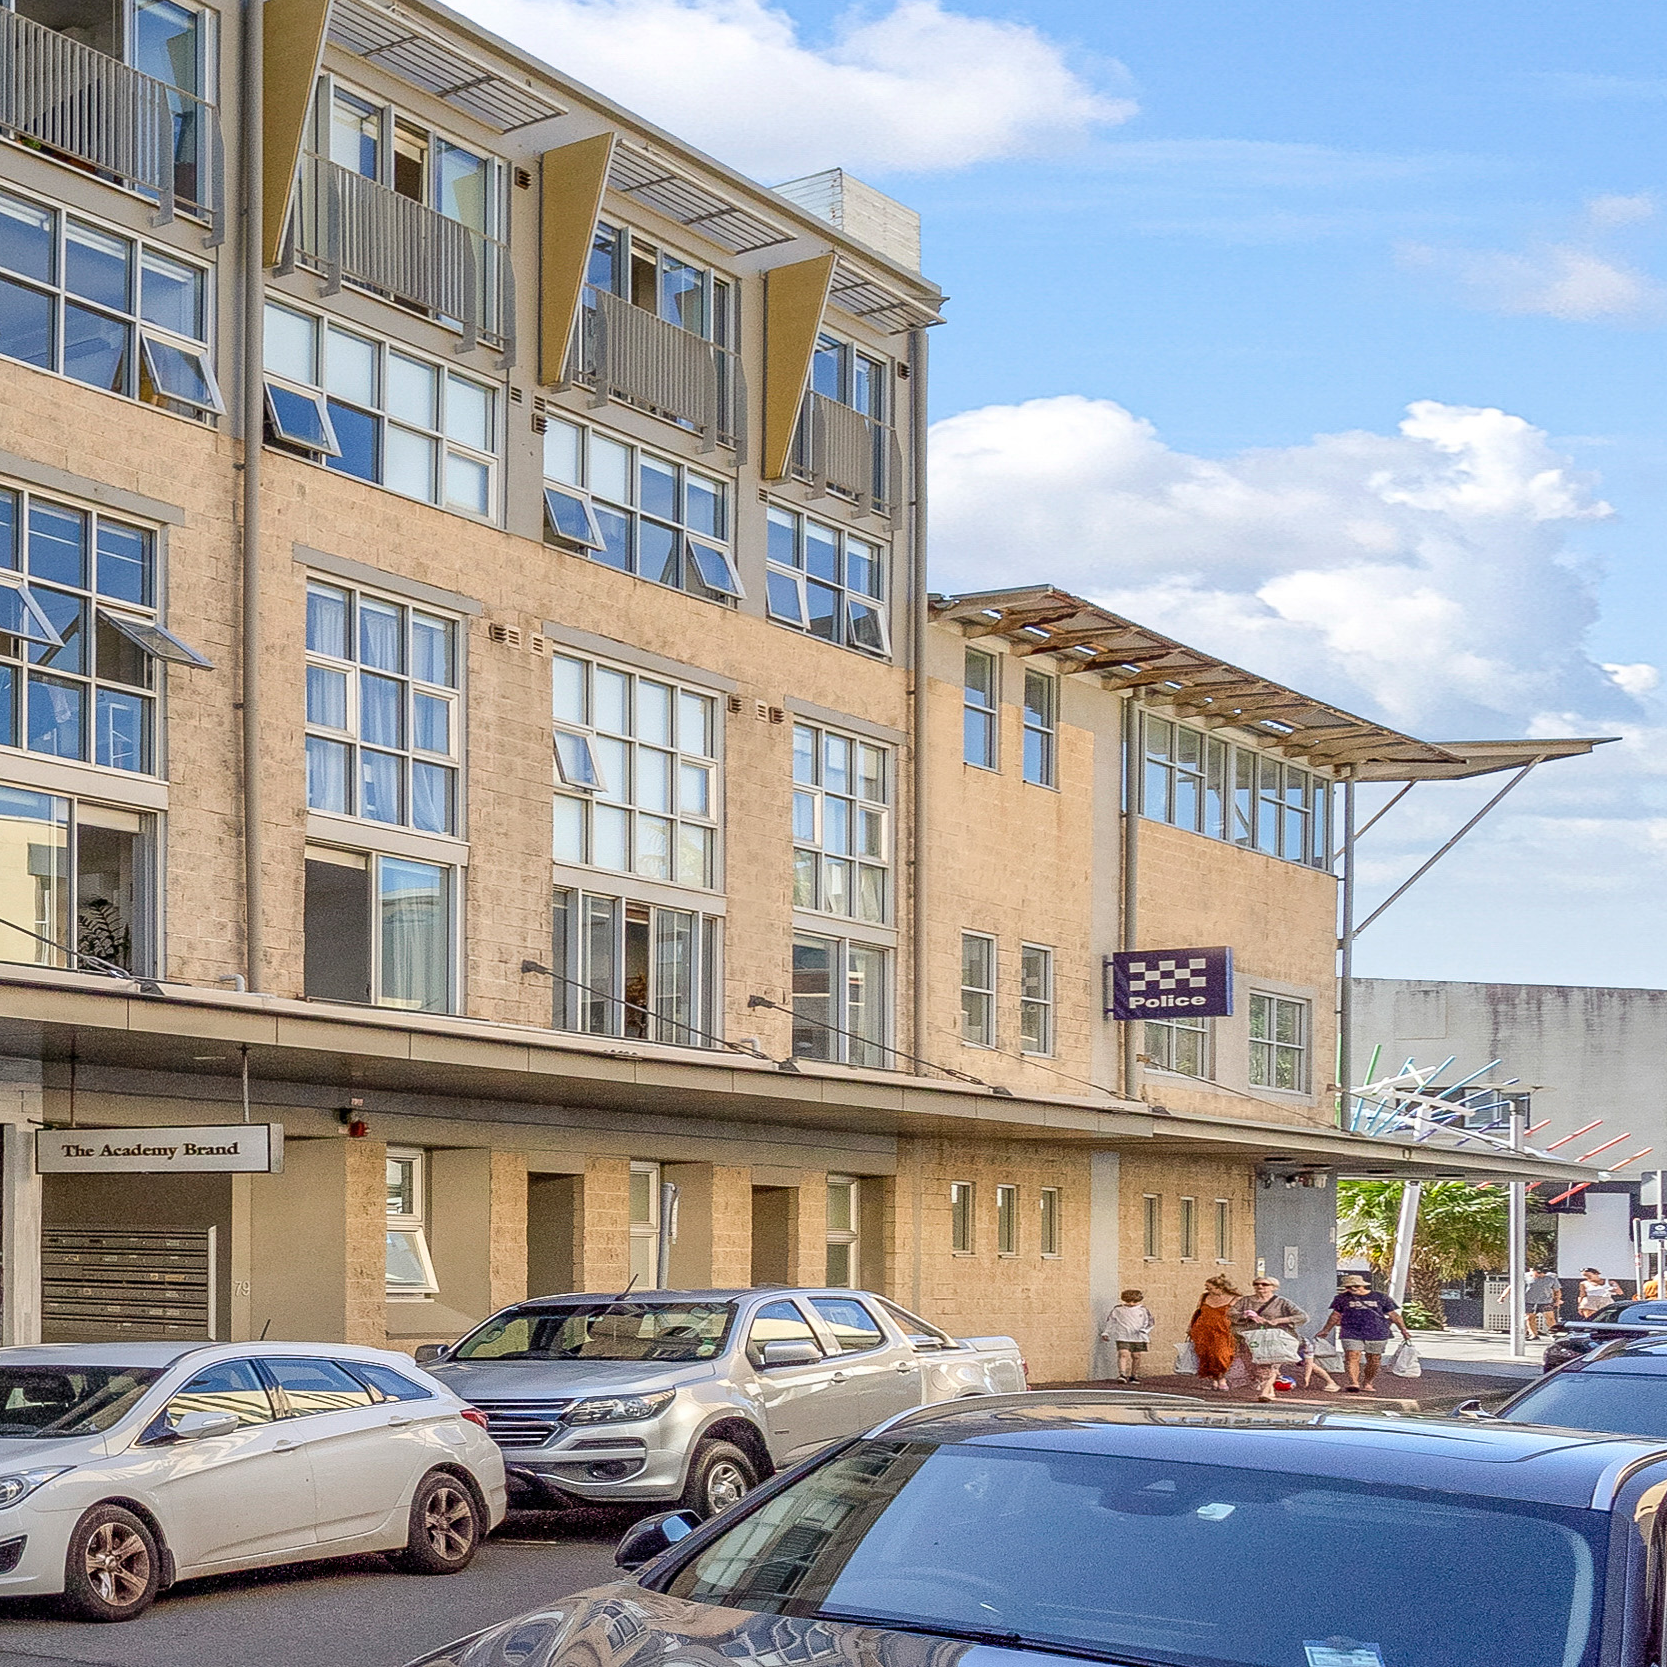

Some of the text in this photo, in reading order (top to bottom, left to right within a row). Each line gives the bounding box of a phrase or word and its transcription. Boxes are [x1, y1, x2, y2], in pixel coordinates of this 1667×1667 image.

[1128, 995, 1206, 1009] Police
[62, 1142, 240, 1160] The Academy Brand
[233, 1280, 251, 1297] 79
